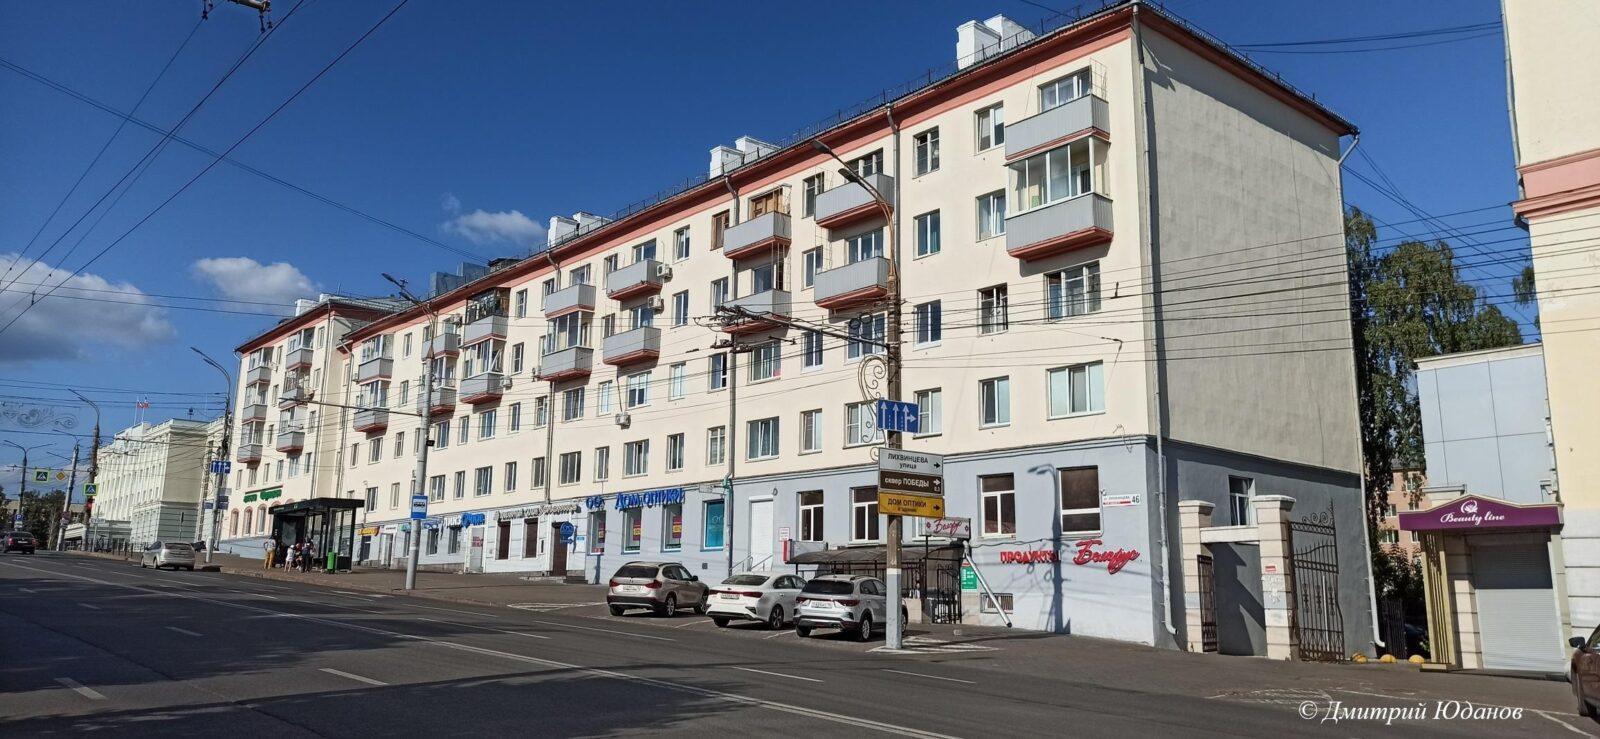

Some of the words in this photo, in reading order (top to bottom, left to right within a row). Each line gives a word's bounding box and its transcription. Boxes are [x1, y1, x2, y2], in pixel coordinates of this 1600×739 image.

[888, 453, 928, 463] ЛИХВИНЦЕВА
[903, 478, 929, 487] ПОБЕДЫ
[888, 498, 902, 506] ДОМ
[903, 499, 927, 507] ОПТИКИ
[1131, 495, 1140, 504] 46
[1440, 512, 1482, 525] Beauty
[1484, 511, 1504, 521] line
[1000, 549, 1061, 564] ПРОДУКТЫ
